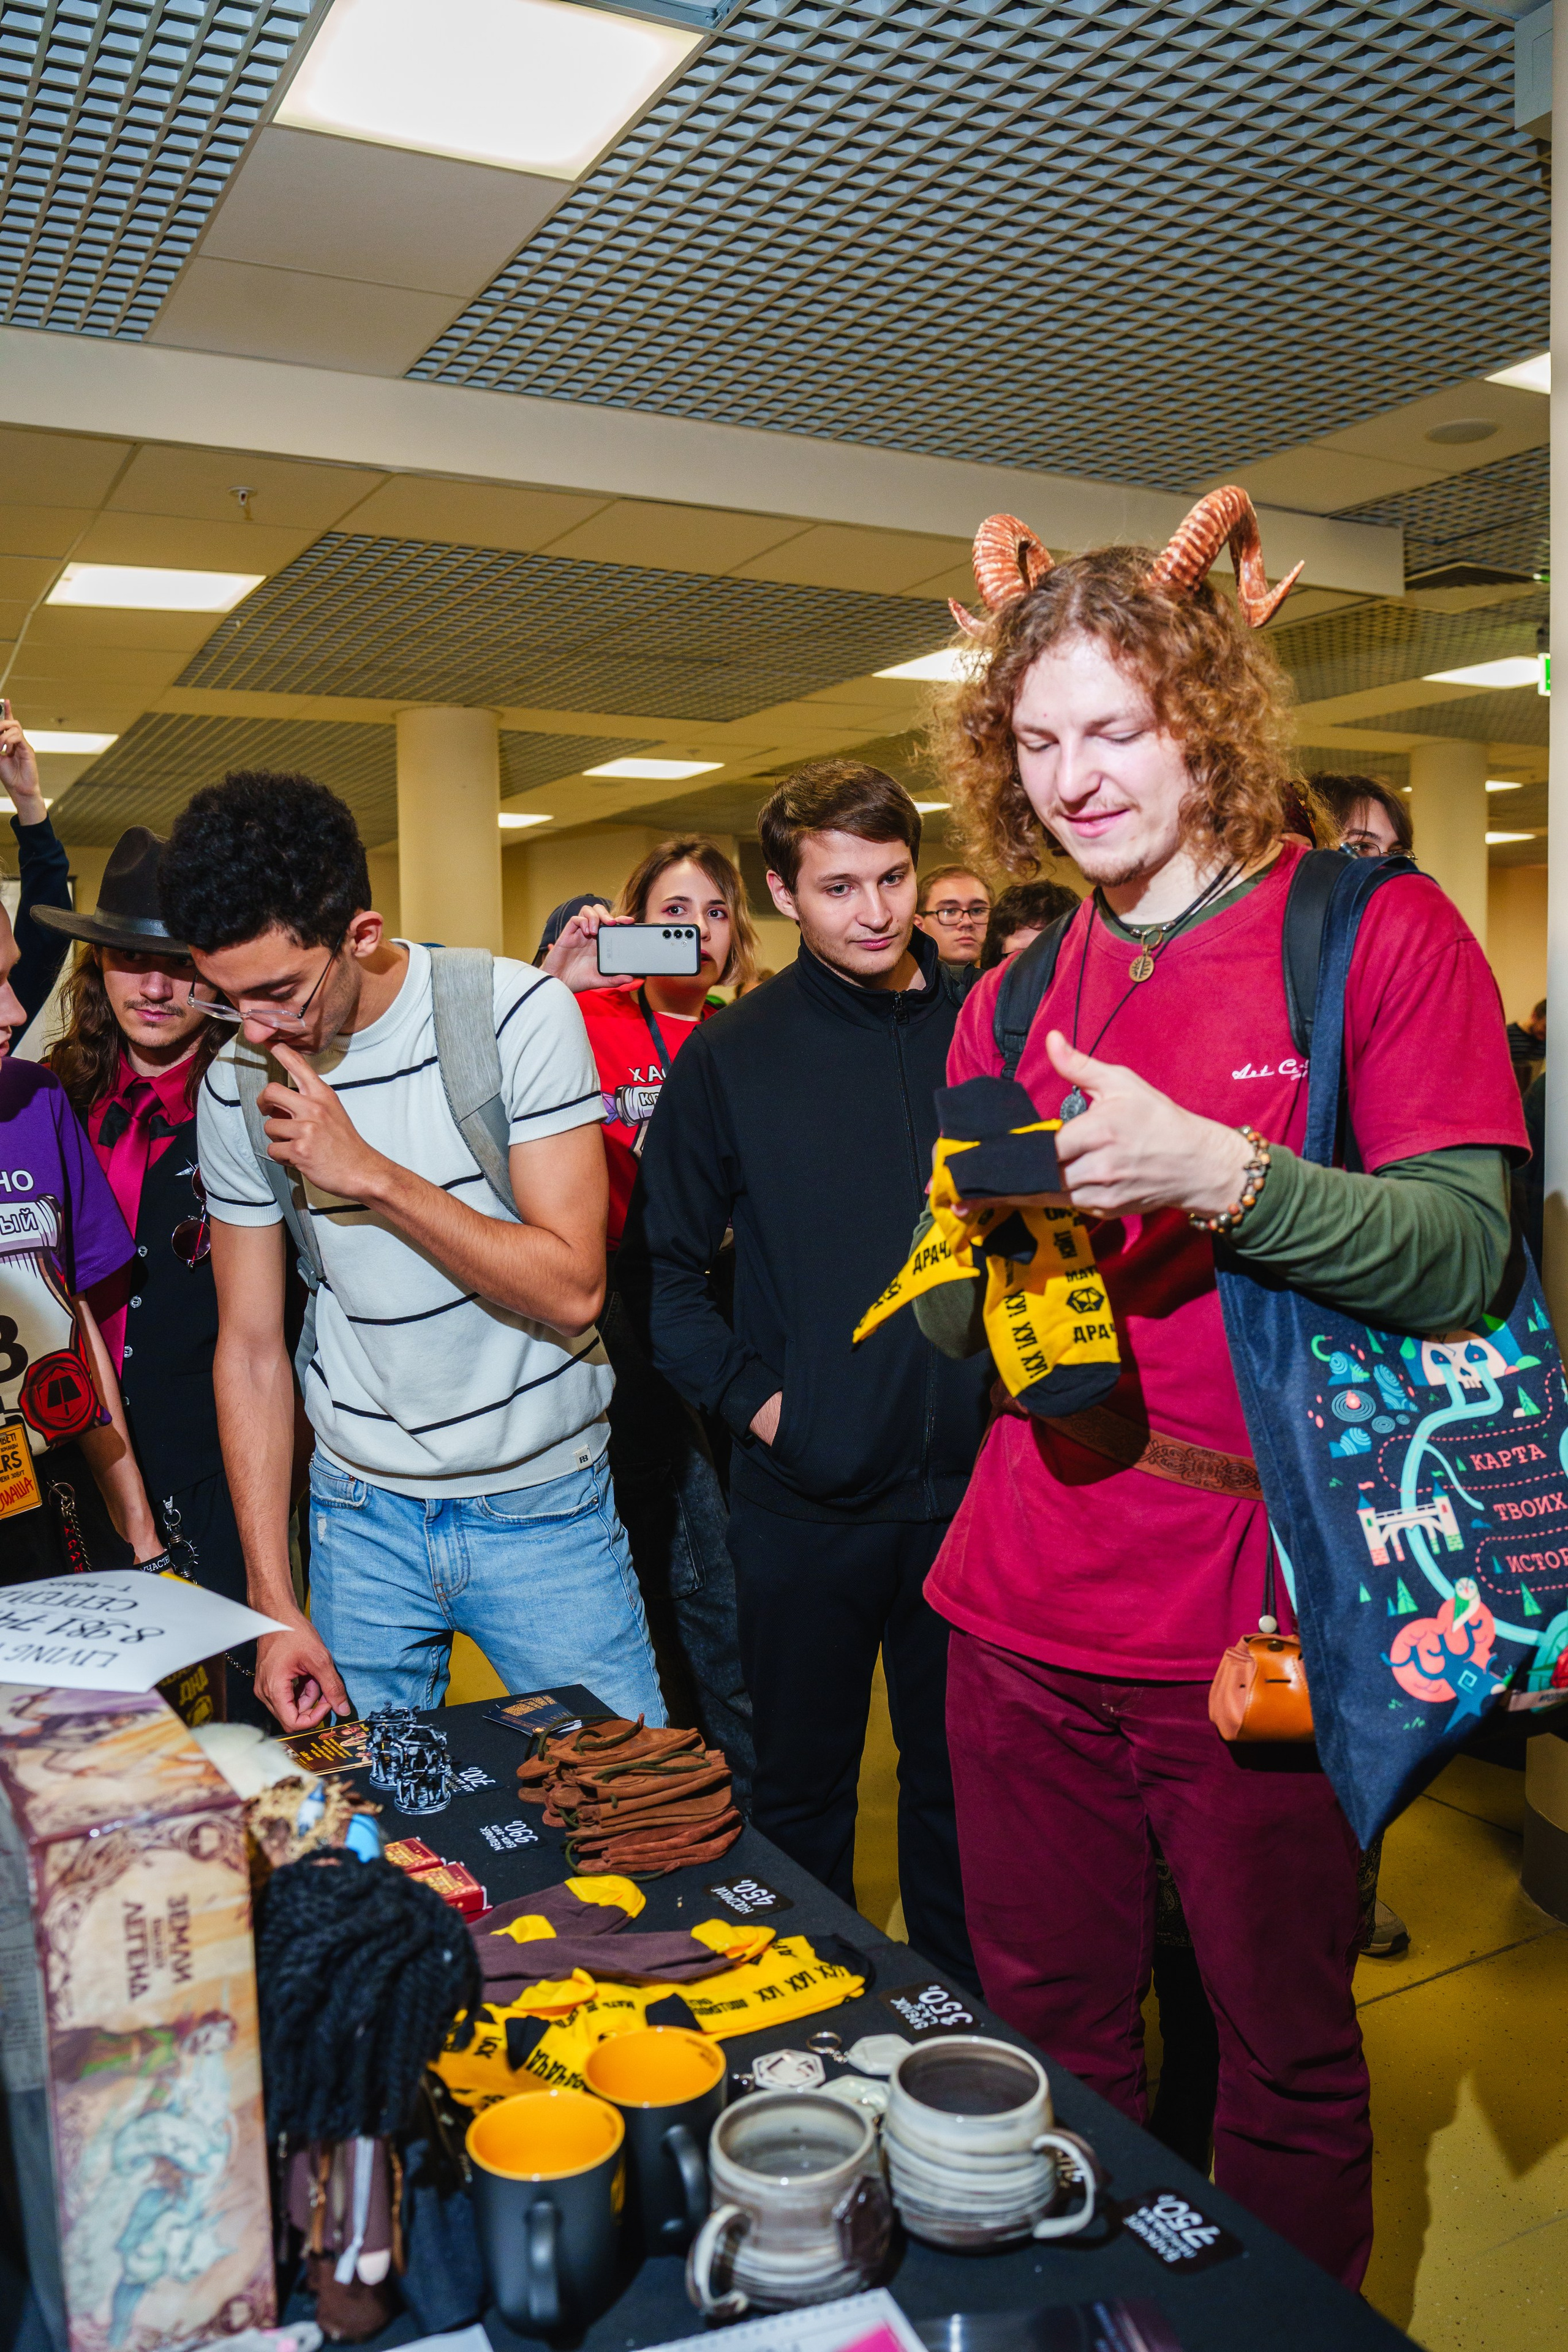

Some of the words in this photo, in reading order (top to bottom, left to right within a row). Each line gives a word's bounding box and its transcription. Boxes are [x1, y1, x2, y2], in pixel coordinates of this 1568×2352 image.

[1012, 1321, 1038, 1351] ХУ!
[1470, 1443, 1547, 1471] КАРТА
[1492, 1491, 1568, 1521] ТВОИХ
[45, 1618, 132, 1640] 981
[119, 1626, 165, 1644] 8
